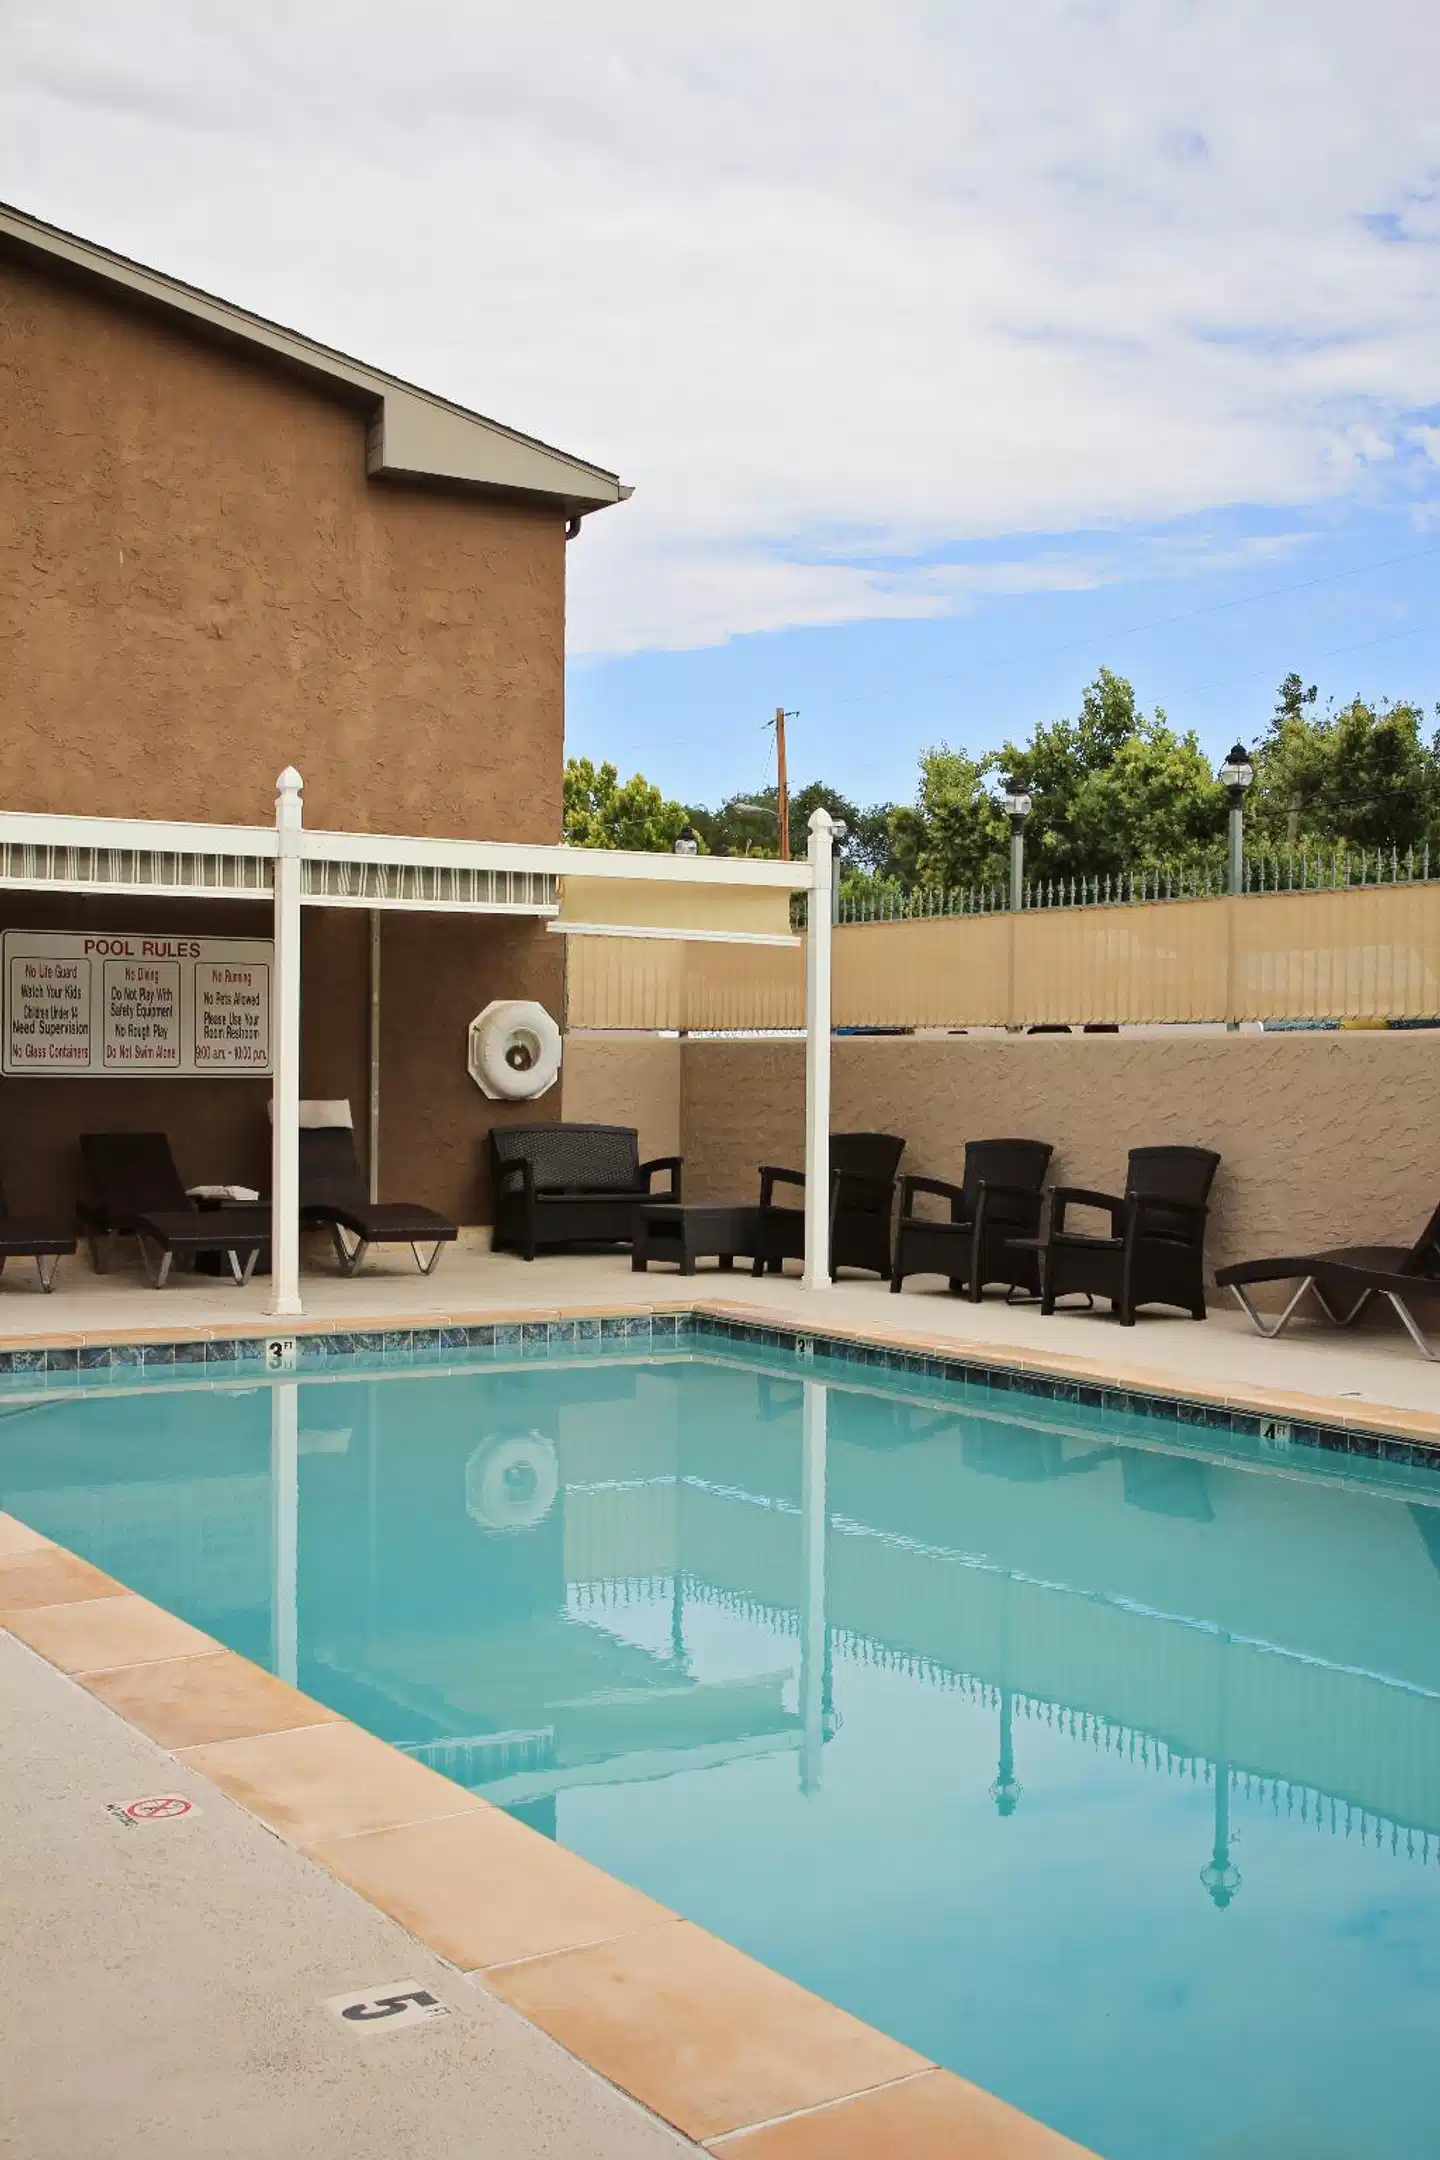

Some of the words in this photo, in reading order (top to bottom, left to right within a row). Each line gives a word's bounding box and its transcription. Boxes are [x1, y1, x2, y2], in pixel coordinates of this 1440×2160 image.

[84, 940, 134, 955] POOL
[142, 941, 201, 958] RULES
[25, 964, 36, 979] No
[39, 964, 52, 979] Life
[55, 964, 77, 979] Guard
[125, 967, 135, 981] No
[212, 969, 222, 983] No
[224, 969, 252, 986] Running
[21, 984, 43, 999] Watch
[46, 984, 62, 999] Your
[65, 984, 81, 999] Kids
[111, 986, 122, 1001] Do
[123, 987, 137, 1001] Not
[139, 987, 155, 1004] Play
[156, 987, 173, 1001] With
[203, 991, 213, 1005] No
[216, 992, 232, 1005] Pets
[234, 992, 260, 1006] Allowed
[110, 1003, 134, 1020] Safety
[136, 1003, 173, 1020] Equipment
[203, 1011, 226, 1026] Please
[229, 1012, 242, 1026] Use
[245, 1012, 260, 1026] Your
[13, 1019, 35, 1034] Need
[39, 1020, 88, 1037] Supervision
[115, 1023, 126, 1038] No
[128, 1023, 150, 1040] Rough
[153, 1024, 168, 1041] Play
[203, 1026, 225, 1039] Room
[227, 1026, 260, 1040] Restroom
[12, 1044, 22, 1058] No
[25, 1044, 46, 1058] Glass
[49, 1044, 88, 1059] Containers
[106, 1045, 117, 1058] Do
[119, 1045, 132, 1059] Not
[135, 1045, 155, 1059] Swim
[156, 1045, 176, 1059] Alone
[284, 1341, 293, 1349] FT
[1263, 1423, 1275, 1439] 4
[341, 1990, 439, 2021] 5
